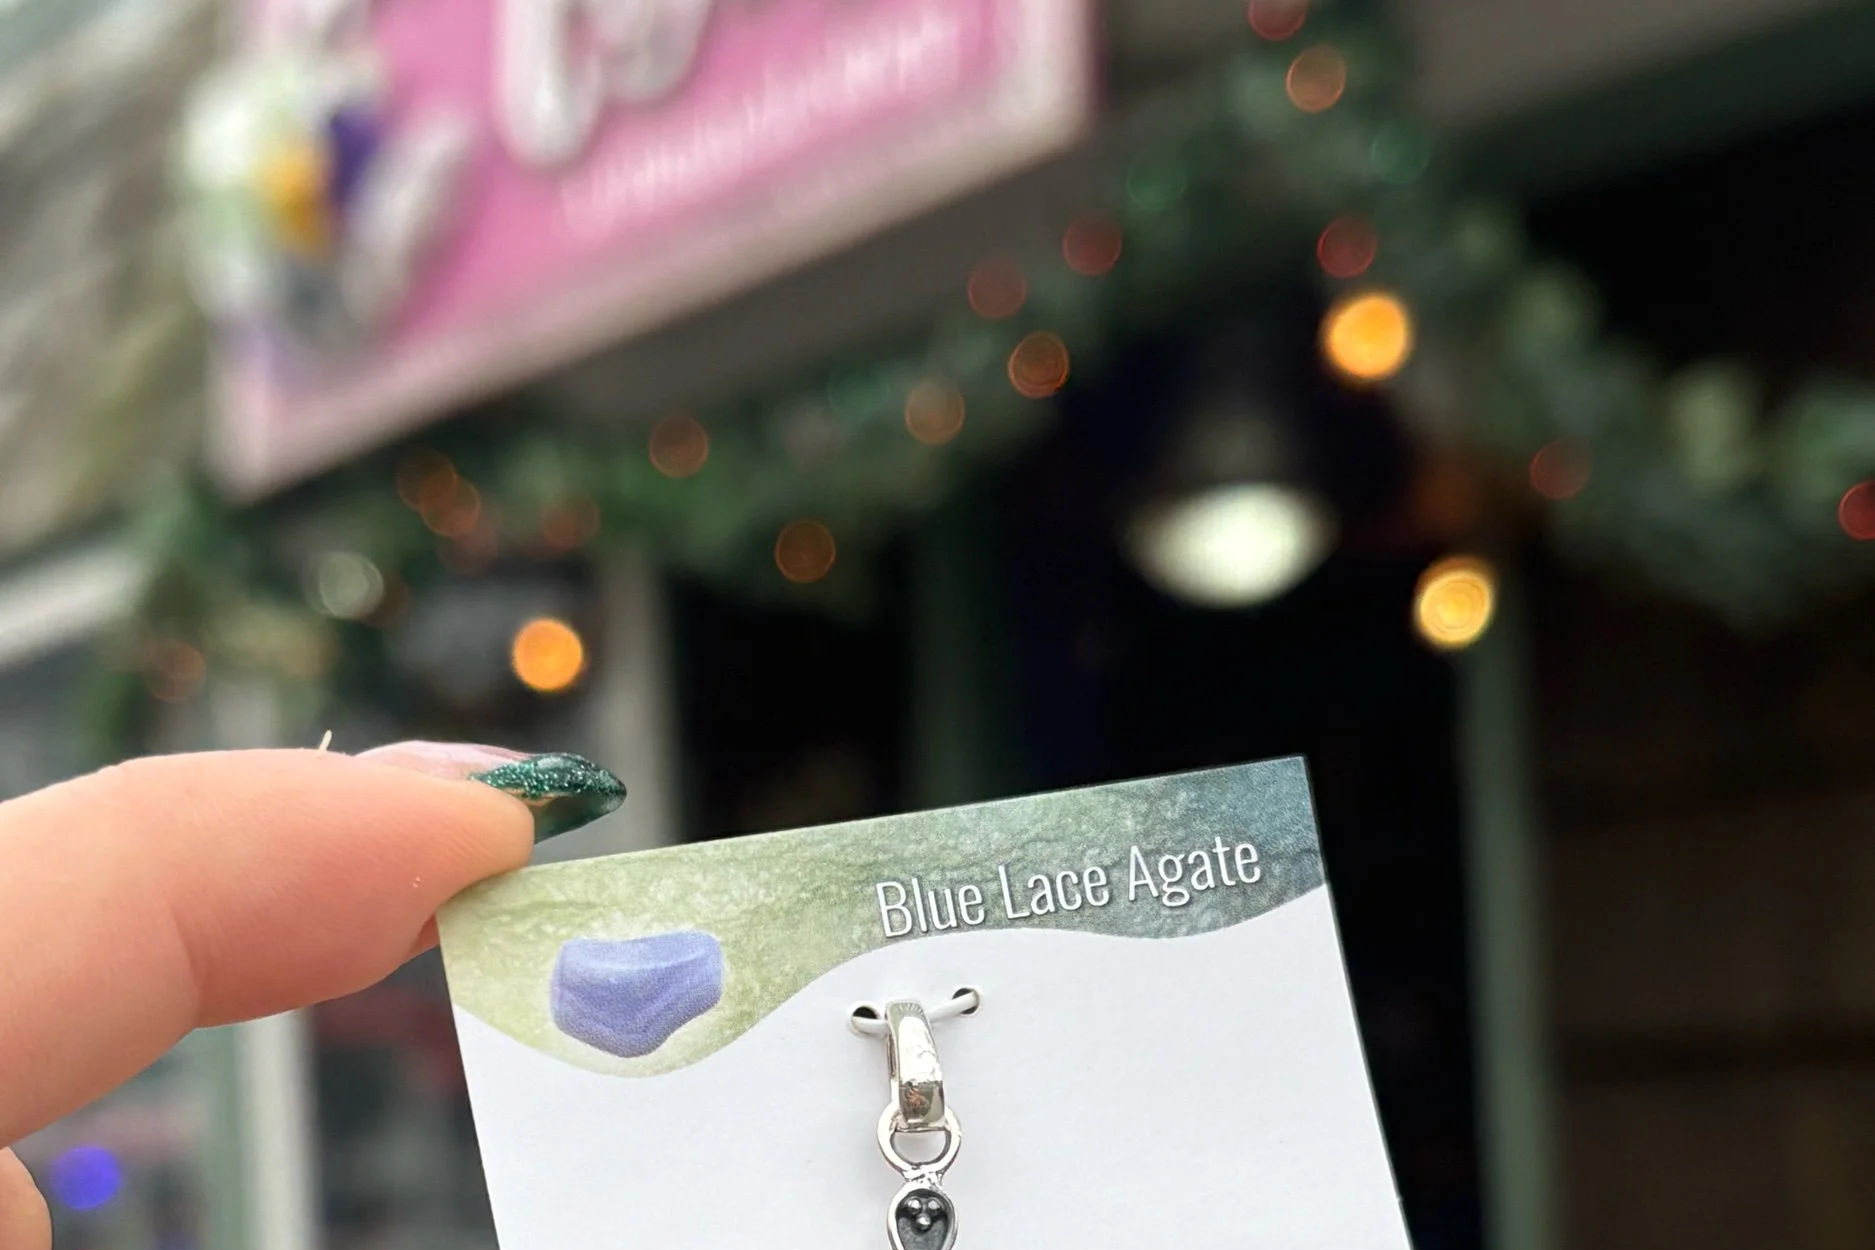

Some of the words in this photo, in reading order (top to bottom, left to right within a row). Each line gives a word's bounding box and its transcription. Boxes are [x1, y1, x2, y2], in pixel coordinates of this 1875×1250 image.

[876, 877, 985, 938] Blue
[998, 863, 1109, 920] Lace
[1127, 836, 1262, 907] Agate
